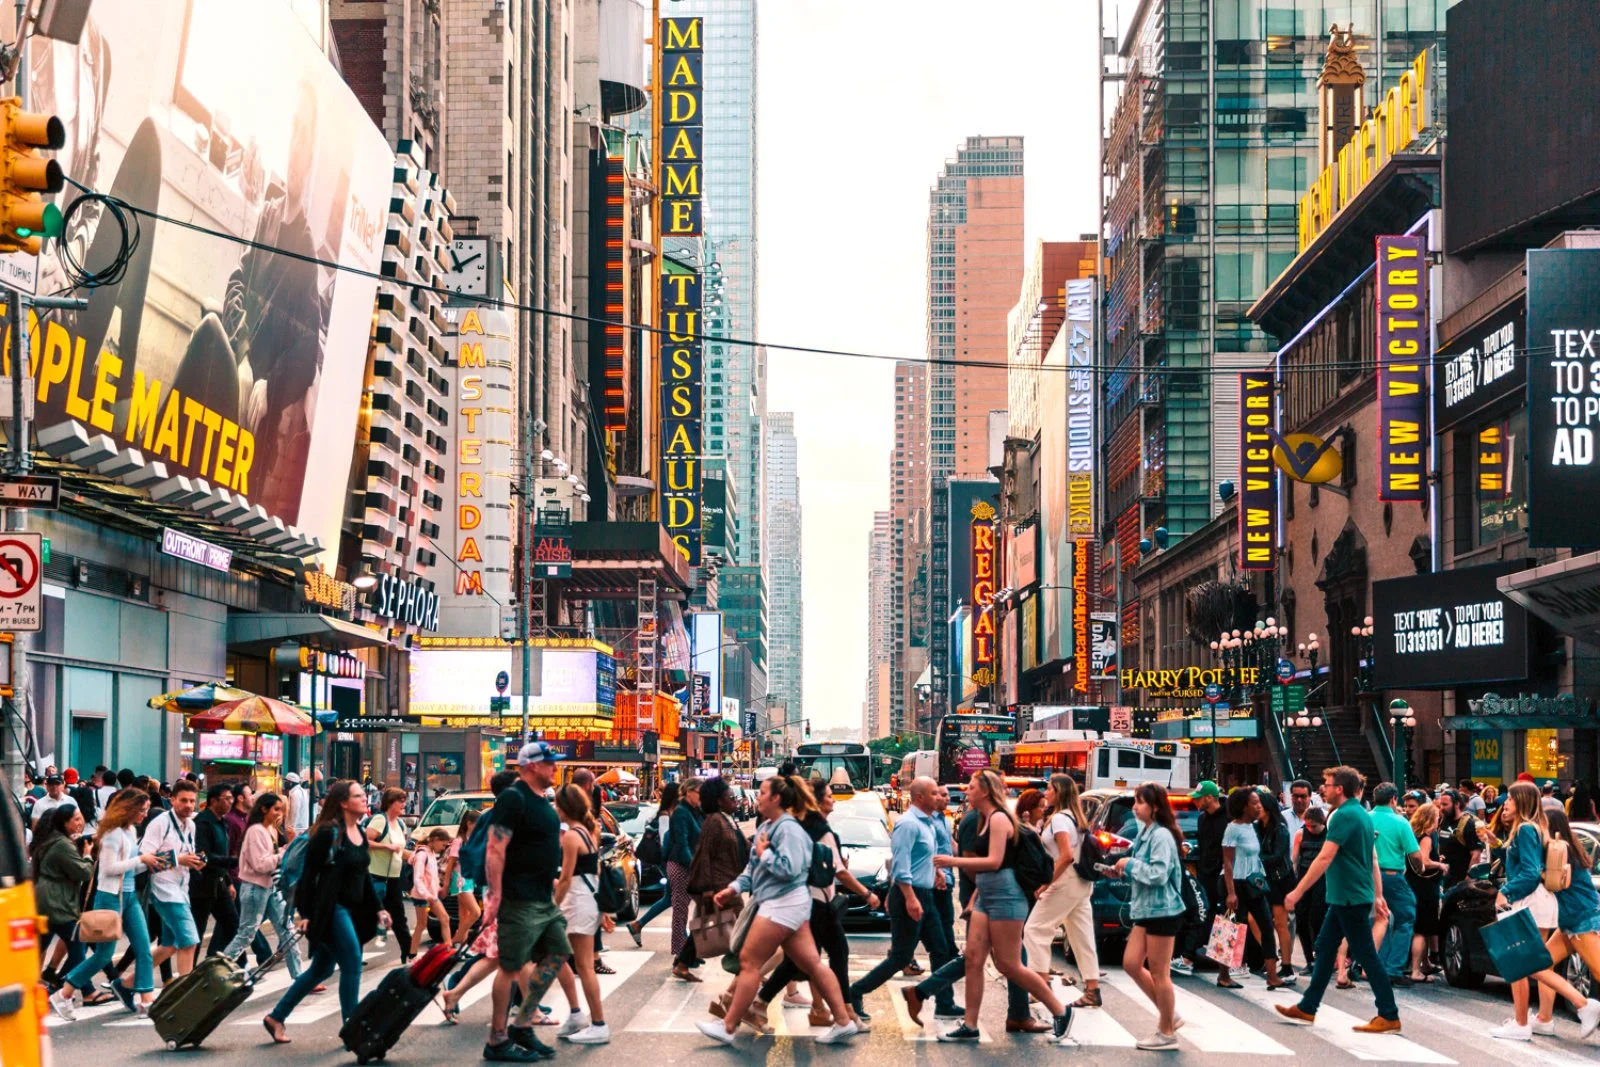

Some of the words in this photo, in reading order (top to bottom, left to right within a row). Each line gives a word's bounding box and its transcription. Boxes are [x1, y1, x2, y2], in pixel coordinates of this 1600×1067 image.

[665, 18, 701, 233] MADAME
[1299, 162, 1334, 253] NEW
[1338, 48, 1427, 208] VICTORY
[455, 241, 463, 249] 12
[9, 263, 32, 283] TURNS
[1068, 281, 1091, 321] NEW
[1387, 246, 1418, 396] VICTORY
[1551, 329, 1600, 358] TEX
[1551, 361, 1583, 394] TO
[1590, 361, 1600, 394] 3
[665, 275, 697, 562] TUSSAUDS
[1551, 397, 1580, 425] TO
[1585, 397, 1600, 425] P
[125, 370, 255, 495] MATTER
[1068, 393, 1092, 471] STUDIOS
[1247, 378, 1269, 491] VICTORY
[1552, 428, 1594, 466] AD
[457, 310, 485, 595] AMSTERDAM
[1389, 420, 1419, 490] NEW
[18, 485, 47, 498] WAY
[1069, 481, 1091, 526] DUKE
[165, 532, 207, 561] OUTFRONT
[537, 537, 569, 550] ALL
[1247, 508, 1270, 560] NEW
[536, 549, 571, 560] RISE
[15, 602, 35, 615] 7PM
[380, 572, 440, 632] SEPHORA
[973, 525, 993, 662] REGAL
[1393, 611, 1415, 631] TEXT
[1455, 606, 1464, 623] TO
[1466, 604, 1481, 622] PUT
[1482, 600, 1503, 620] YOUR
[1091, 624, 1104, 669] DANCE
[1394, 632, 1406, 653] TO
[1407, 628, 1443, 652] 313131
[1455, 624, 1470, 648] AD
[1472, 620, 1504, 646] HERE!
[1121, 668, 1184, 689] HARRY
[1172, 689, 1204, 698] CURSED
[538, 704, 562, 712] SEATS
[1113, 720, 1129, 729] 25
